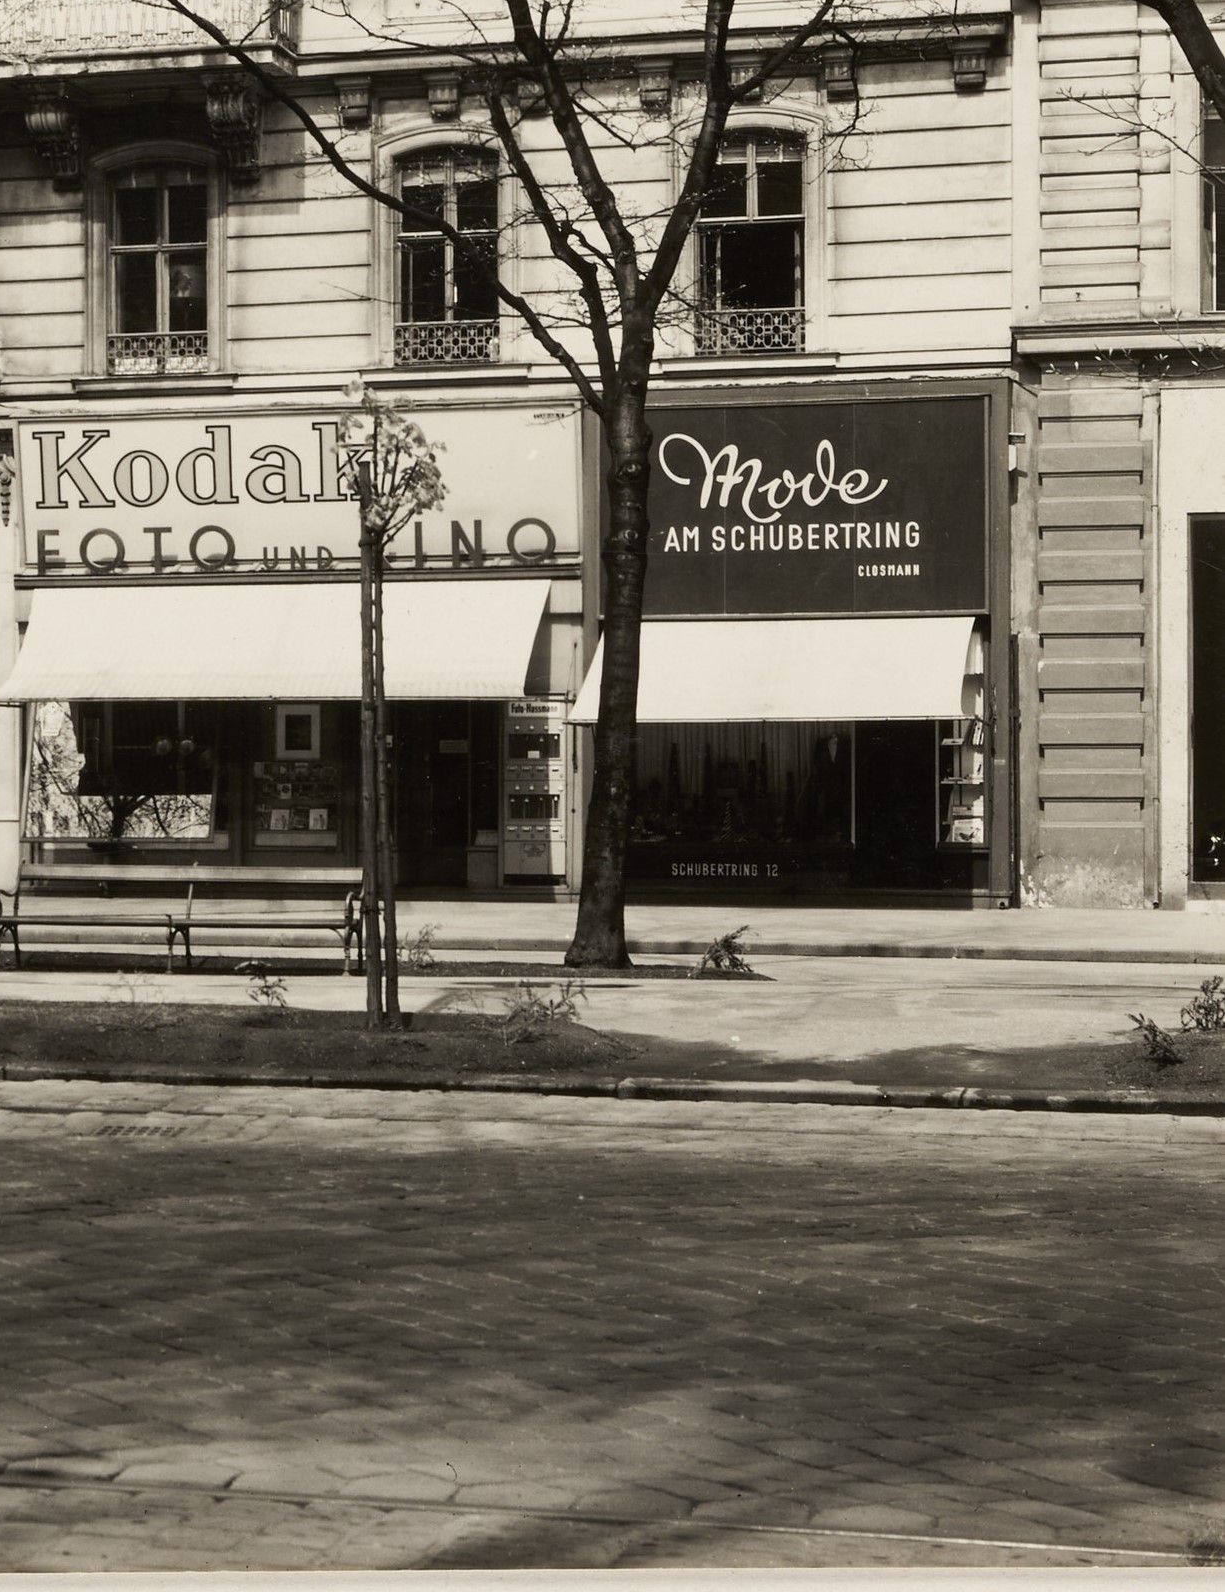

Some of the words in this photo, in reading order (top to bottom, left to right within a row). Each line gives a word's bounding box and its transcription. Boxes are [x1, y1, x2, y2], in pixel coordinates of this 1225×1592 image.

[32, 421, 375, 509] Kodak
[658, 433, 889, 524] Mode
[37, 524, 237, 576] FOTO
[262, 545, 335, 571] UND
[382, 516, 557, 571] INO
[663, 525, 700, 553] AM
[711, 520, 921, 552] SCHUBERTRING
[857, 564, 921, 577] CLOSMANN
[671, 862, 758, 877] SCHUBERTRING
[766, 863, 779, 877] 12
